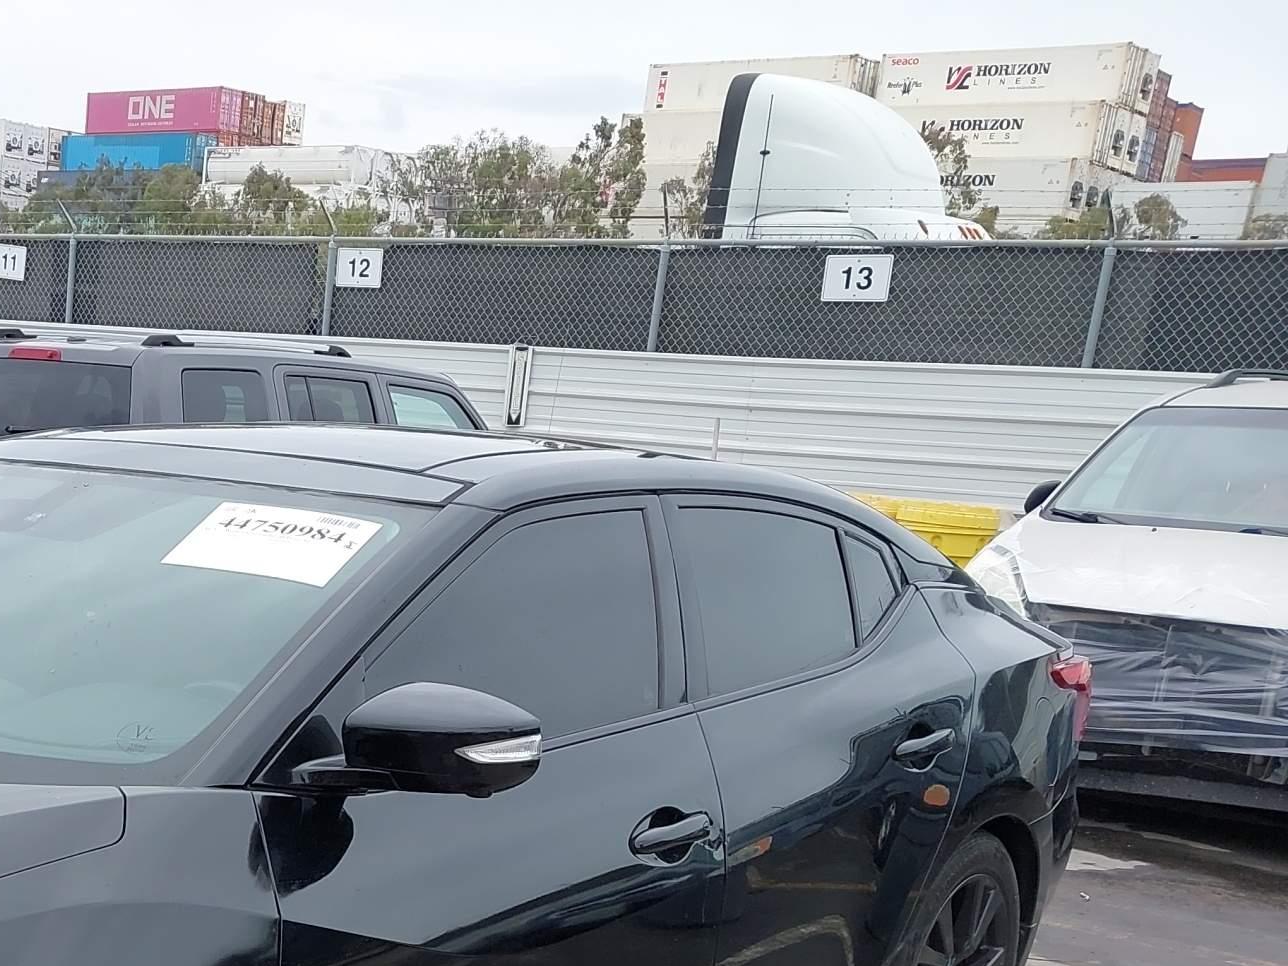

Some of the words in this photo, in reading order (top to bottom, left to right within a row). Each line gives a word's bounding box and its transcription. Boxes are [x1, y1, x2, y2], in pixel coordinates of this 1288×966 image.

[891, 57, 920, 66] seaco
[975, 62, 1052, 77] HORIZON
[973, 77, 1037, 86] LINES
[127, 94, 176, 120] ONE
[949, 118, 1024, 132] HORIZON
[2, 253, 17, 271] 11
[348, 258, 371, 278] 12
[841, 266, 873, 290] 13
[218, 516, 347, 544] 44750984
